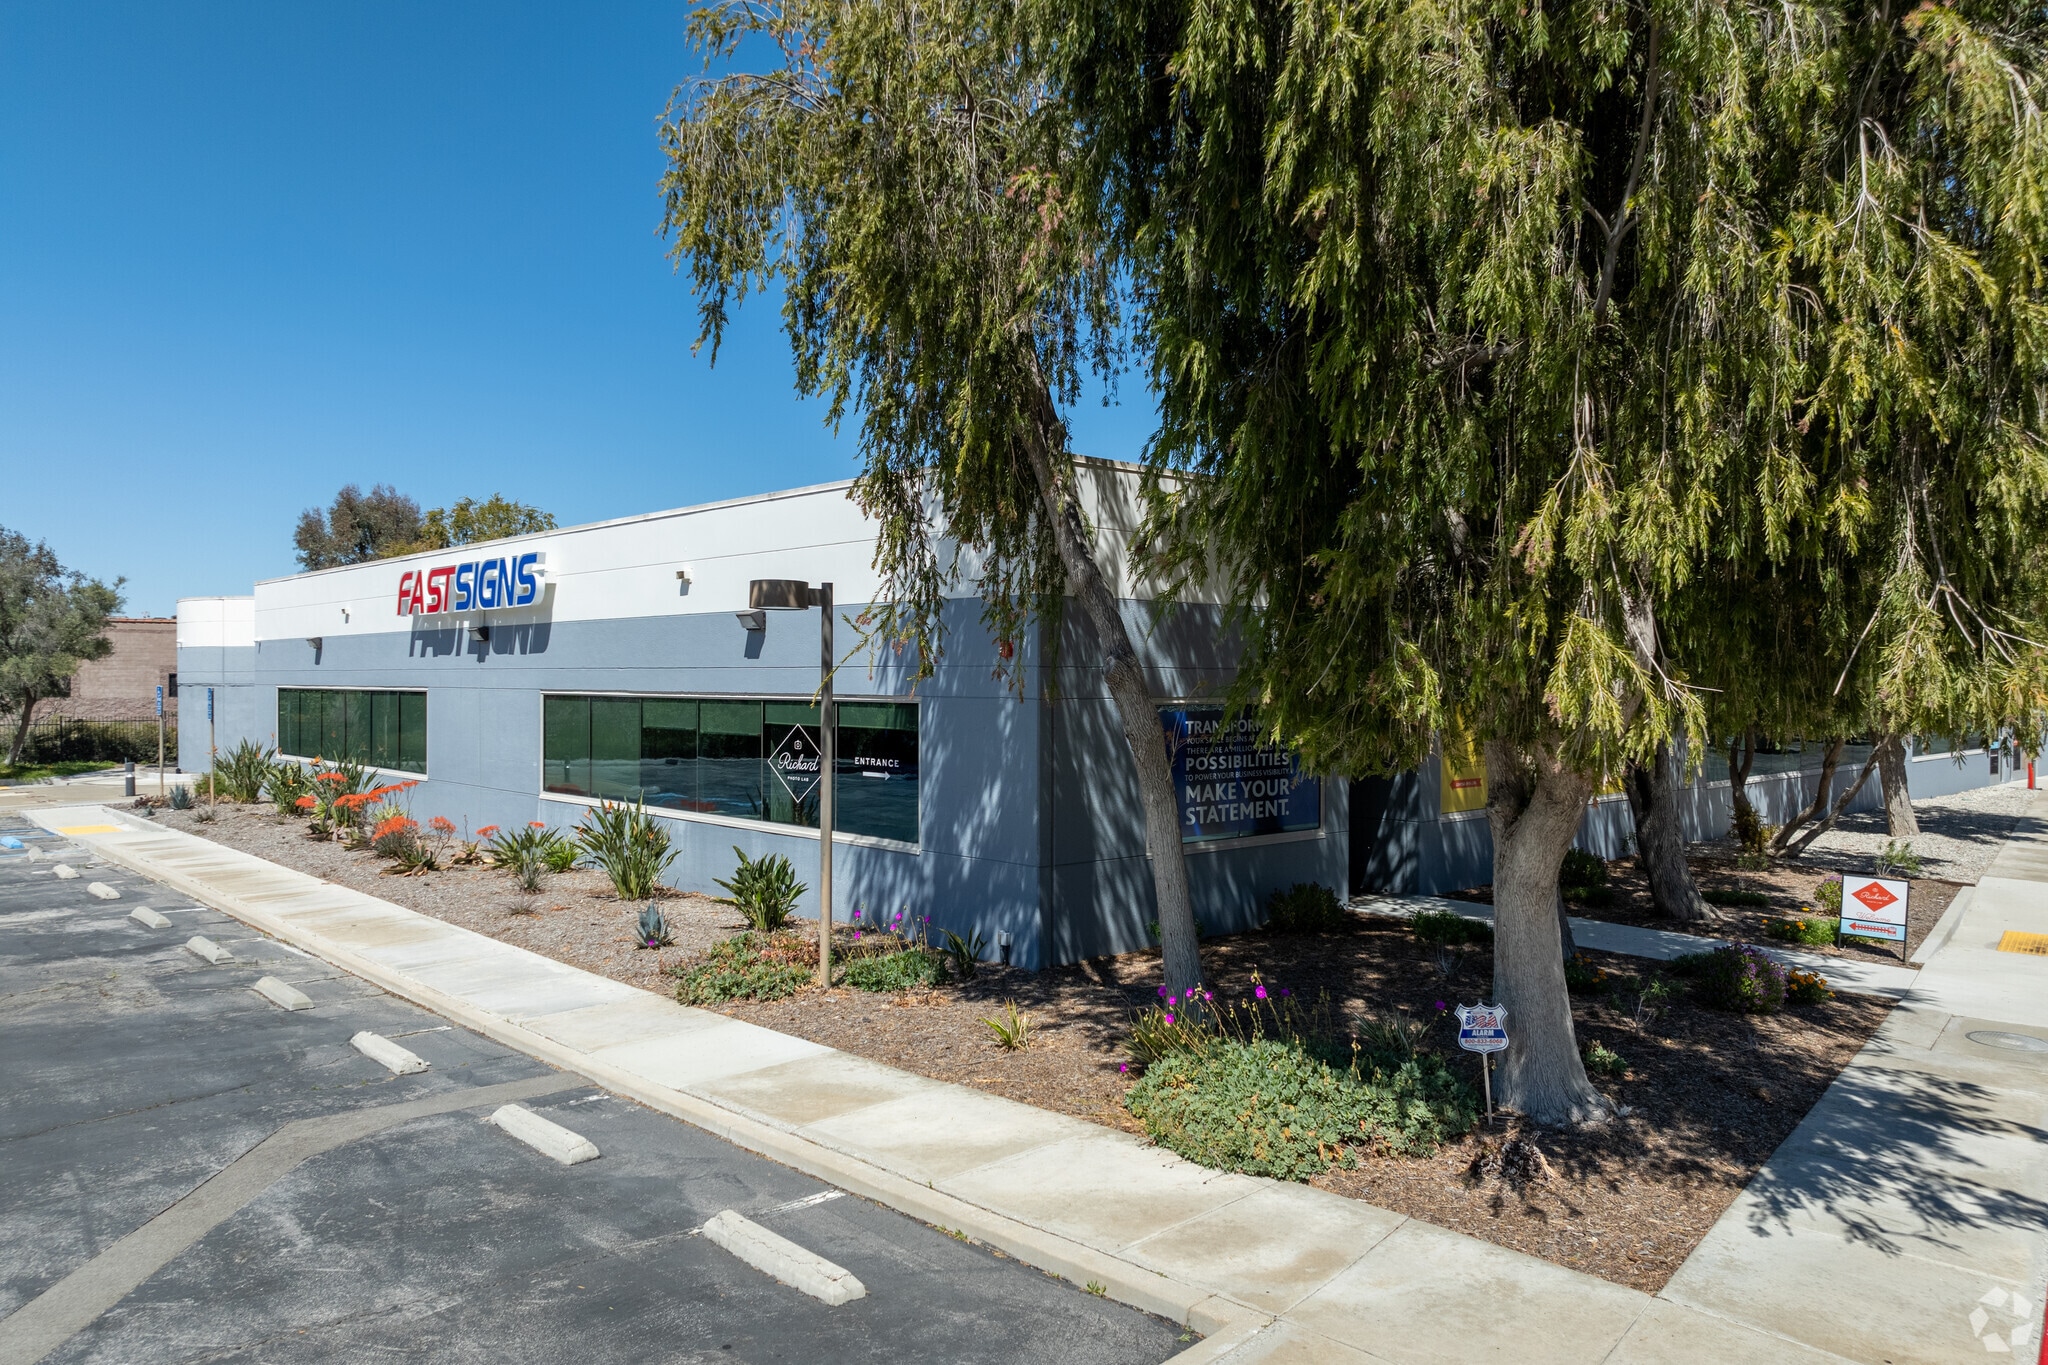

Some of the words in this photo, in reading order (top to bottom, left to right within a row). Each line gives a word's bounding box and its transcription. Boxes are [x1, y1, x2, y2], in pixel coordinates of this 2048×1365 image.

[397, 552, 542, 616] FASTSIGNS
[777, 752, 819, 772] Richard
[854, 757, 900, 768] ENTRANCE
[1186, 753, 1289, 771] POSSIBILITIES
[1185, 774, 1194, 782] TO
[1195, 773, 1217, 781] POWER
[1217, 771, 1235, 780] YOUR
[1235, 770, 1262, 778] BUSINESS
[1185, 782, 1237, 804] MAKE
[1241, 778, 1290, 799] YOUR
[1186, 799, 1289, 825] STATEMENT.
[1860, 891, 1890, 900] Richard
